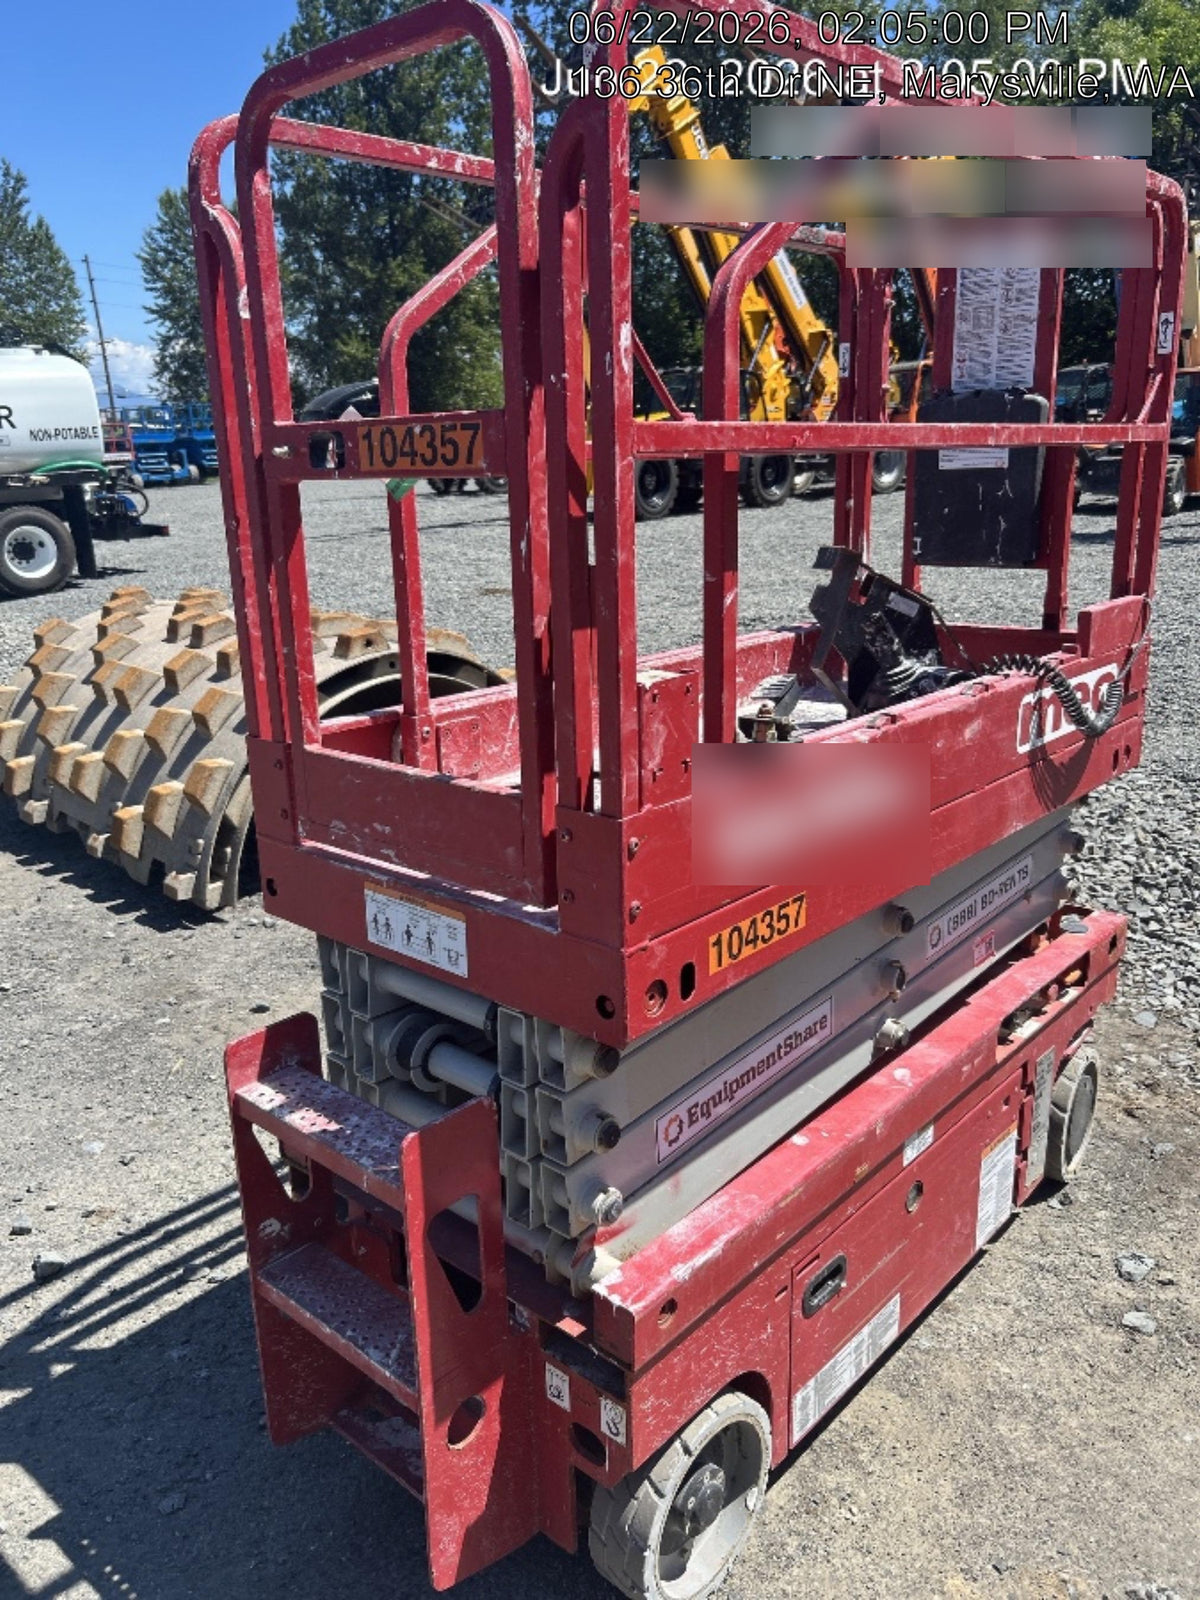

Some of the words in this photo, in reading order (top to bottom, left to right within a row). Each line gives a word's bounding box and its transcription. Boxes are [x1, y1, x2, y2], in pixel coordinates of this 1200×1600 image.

[29, 426, 99, 441] NON-POTABLE
[362, 422, 480, 468] 104357
[712, 894, 806, 968] 104357
[686, 1014, 828, 1128] EquipmentShare
